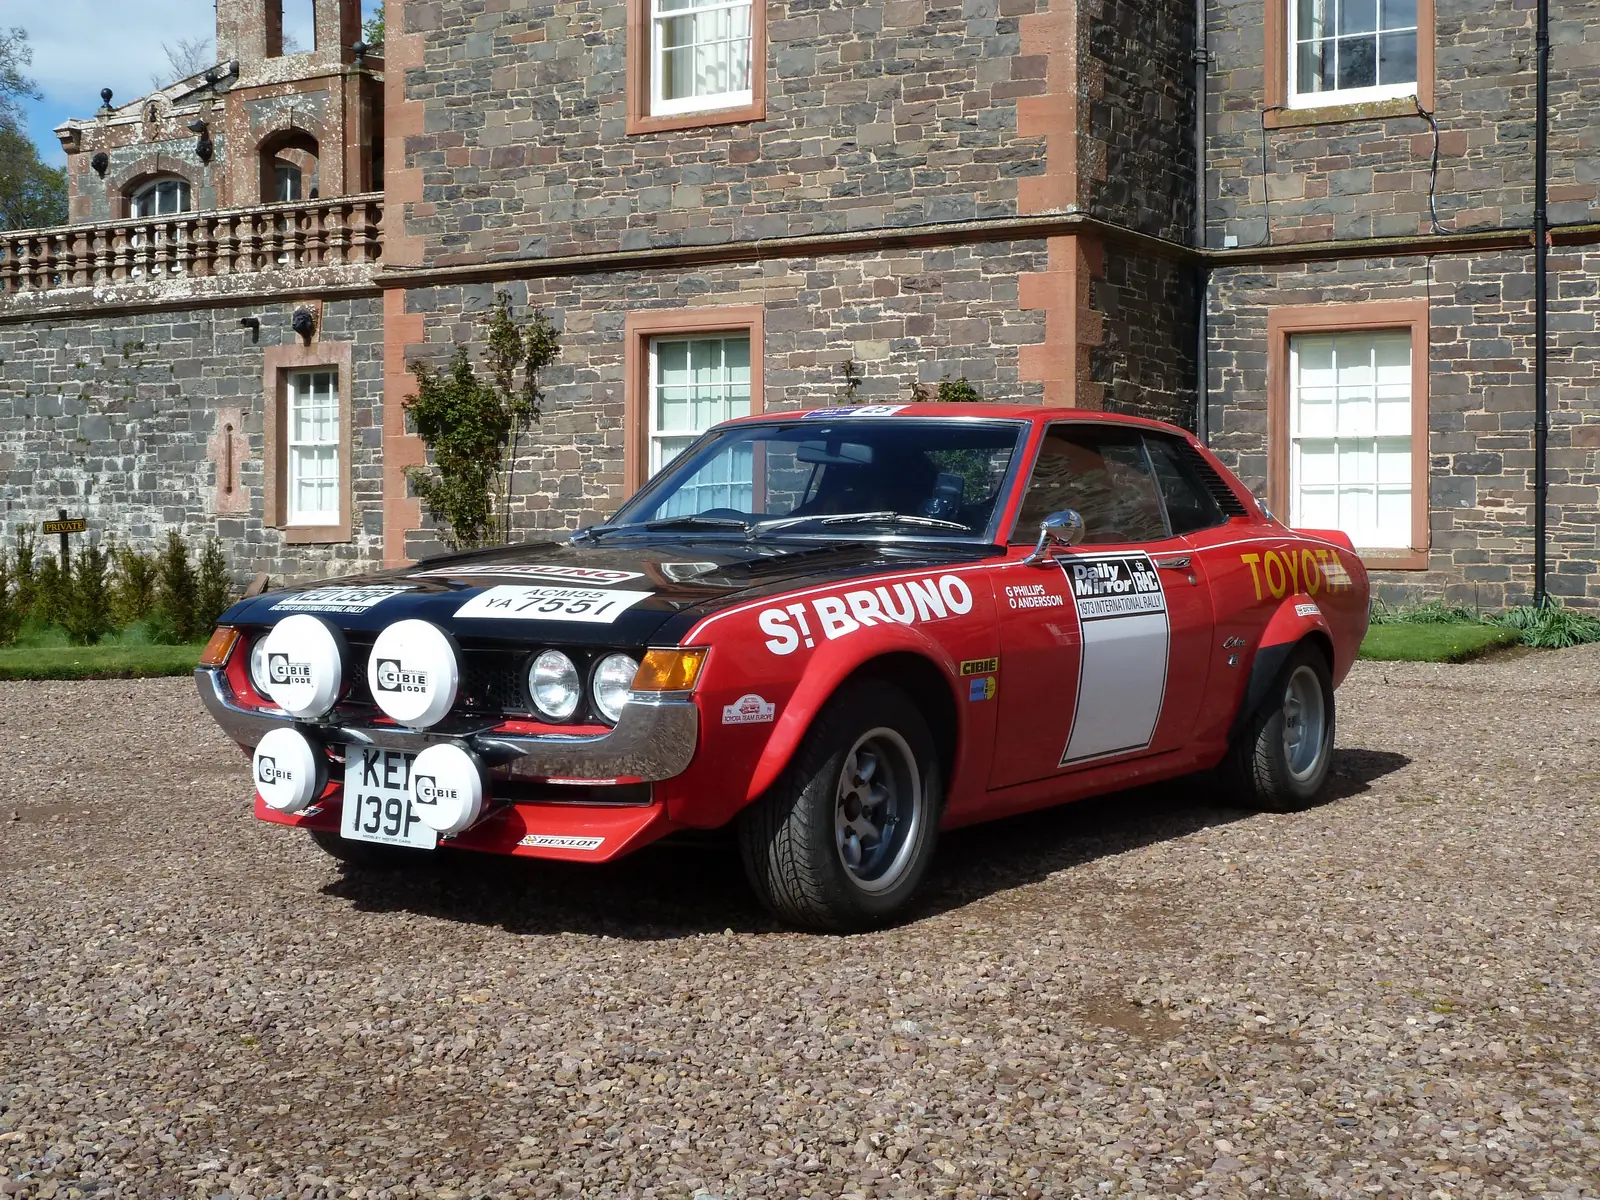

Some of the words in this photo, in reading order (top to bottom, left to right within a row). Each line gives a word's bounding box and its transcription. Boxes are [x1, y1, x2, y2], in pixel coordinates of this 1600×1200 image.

[46, 522, 83, 531] PRIVATE
[1073, 562, 1119, 582] Daily
[1240, 548, 1349, 601] TOYOTA
[1075, 579, 1132, 596] Mirror
[1132, 571, 1159, 592] RAC
[523, 588, 608, 598] ACM55
[1005, 586, 1013, 598] G
[1013, 584, 1046, 597] PHILLIPS
[485, 598, 513, 608] YA
[514, 597, 617, 616] 7551
[812, 575, 973, 640] BRUNO
[1009, 598, 1017, 609] O
[1018, 595, 1064, 608] ANDERSSON
[1080, 601, 1096, 615] 1973
[1095, 597, 1144, 614] INTERNATIONAL
[1143, 595, 1161, 608] RALLY
[386, 672, 426, 685] CIBIE
[402, 685, 426, 693] IODE
[265, 768, 292, 780] CIBIE
[424, 788, 457, 799] CIBIE
[538, 838, 598, 847] DUNLOP
